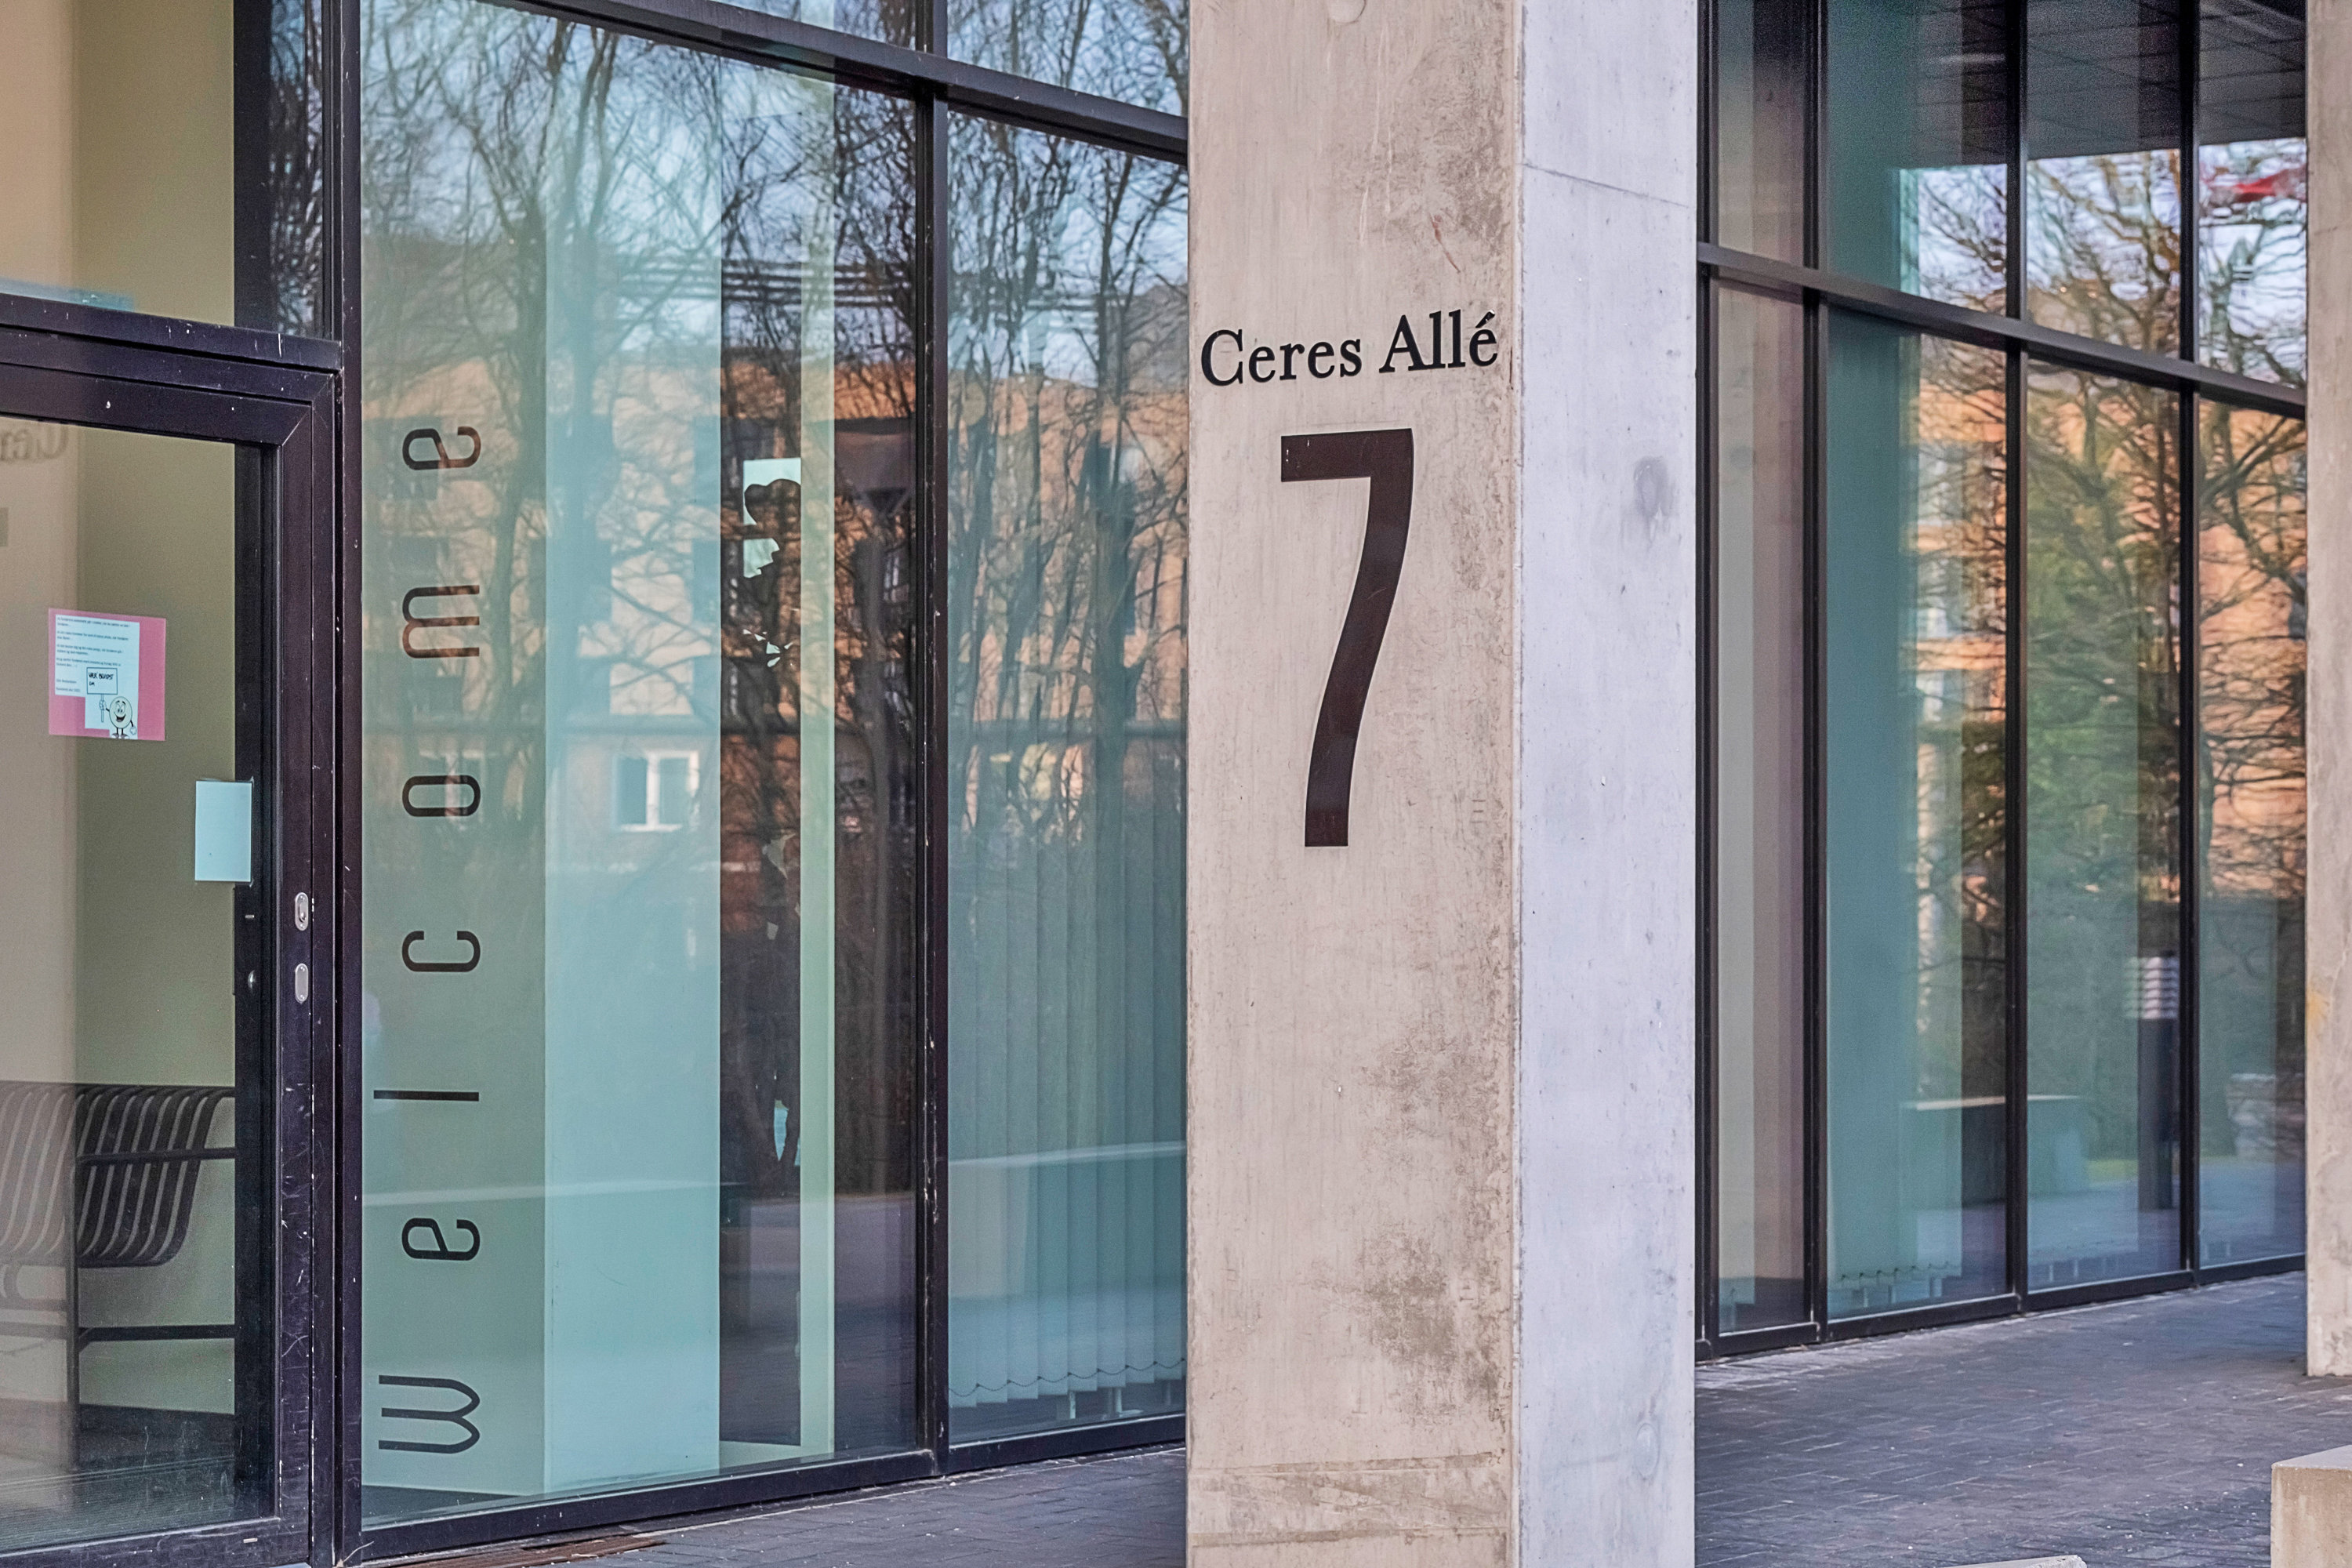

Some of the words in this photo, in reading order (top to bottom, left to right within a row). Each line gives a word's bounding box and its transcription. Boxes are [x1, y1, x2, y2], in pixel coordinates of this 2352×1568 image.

[1200, 328, 1363, 387] Ceres
[1378, 308, 1499, 375] Allé
[1279, 427, 1414, 848] 7
[372, 425, 481, 1456] welcome
